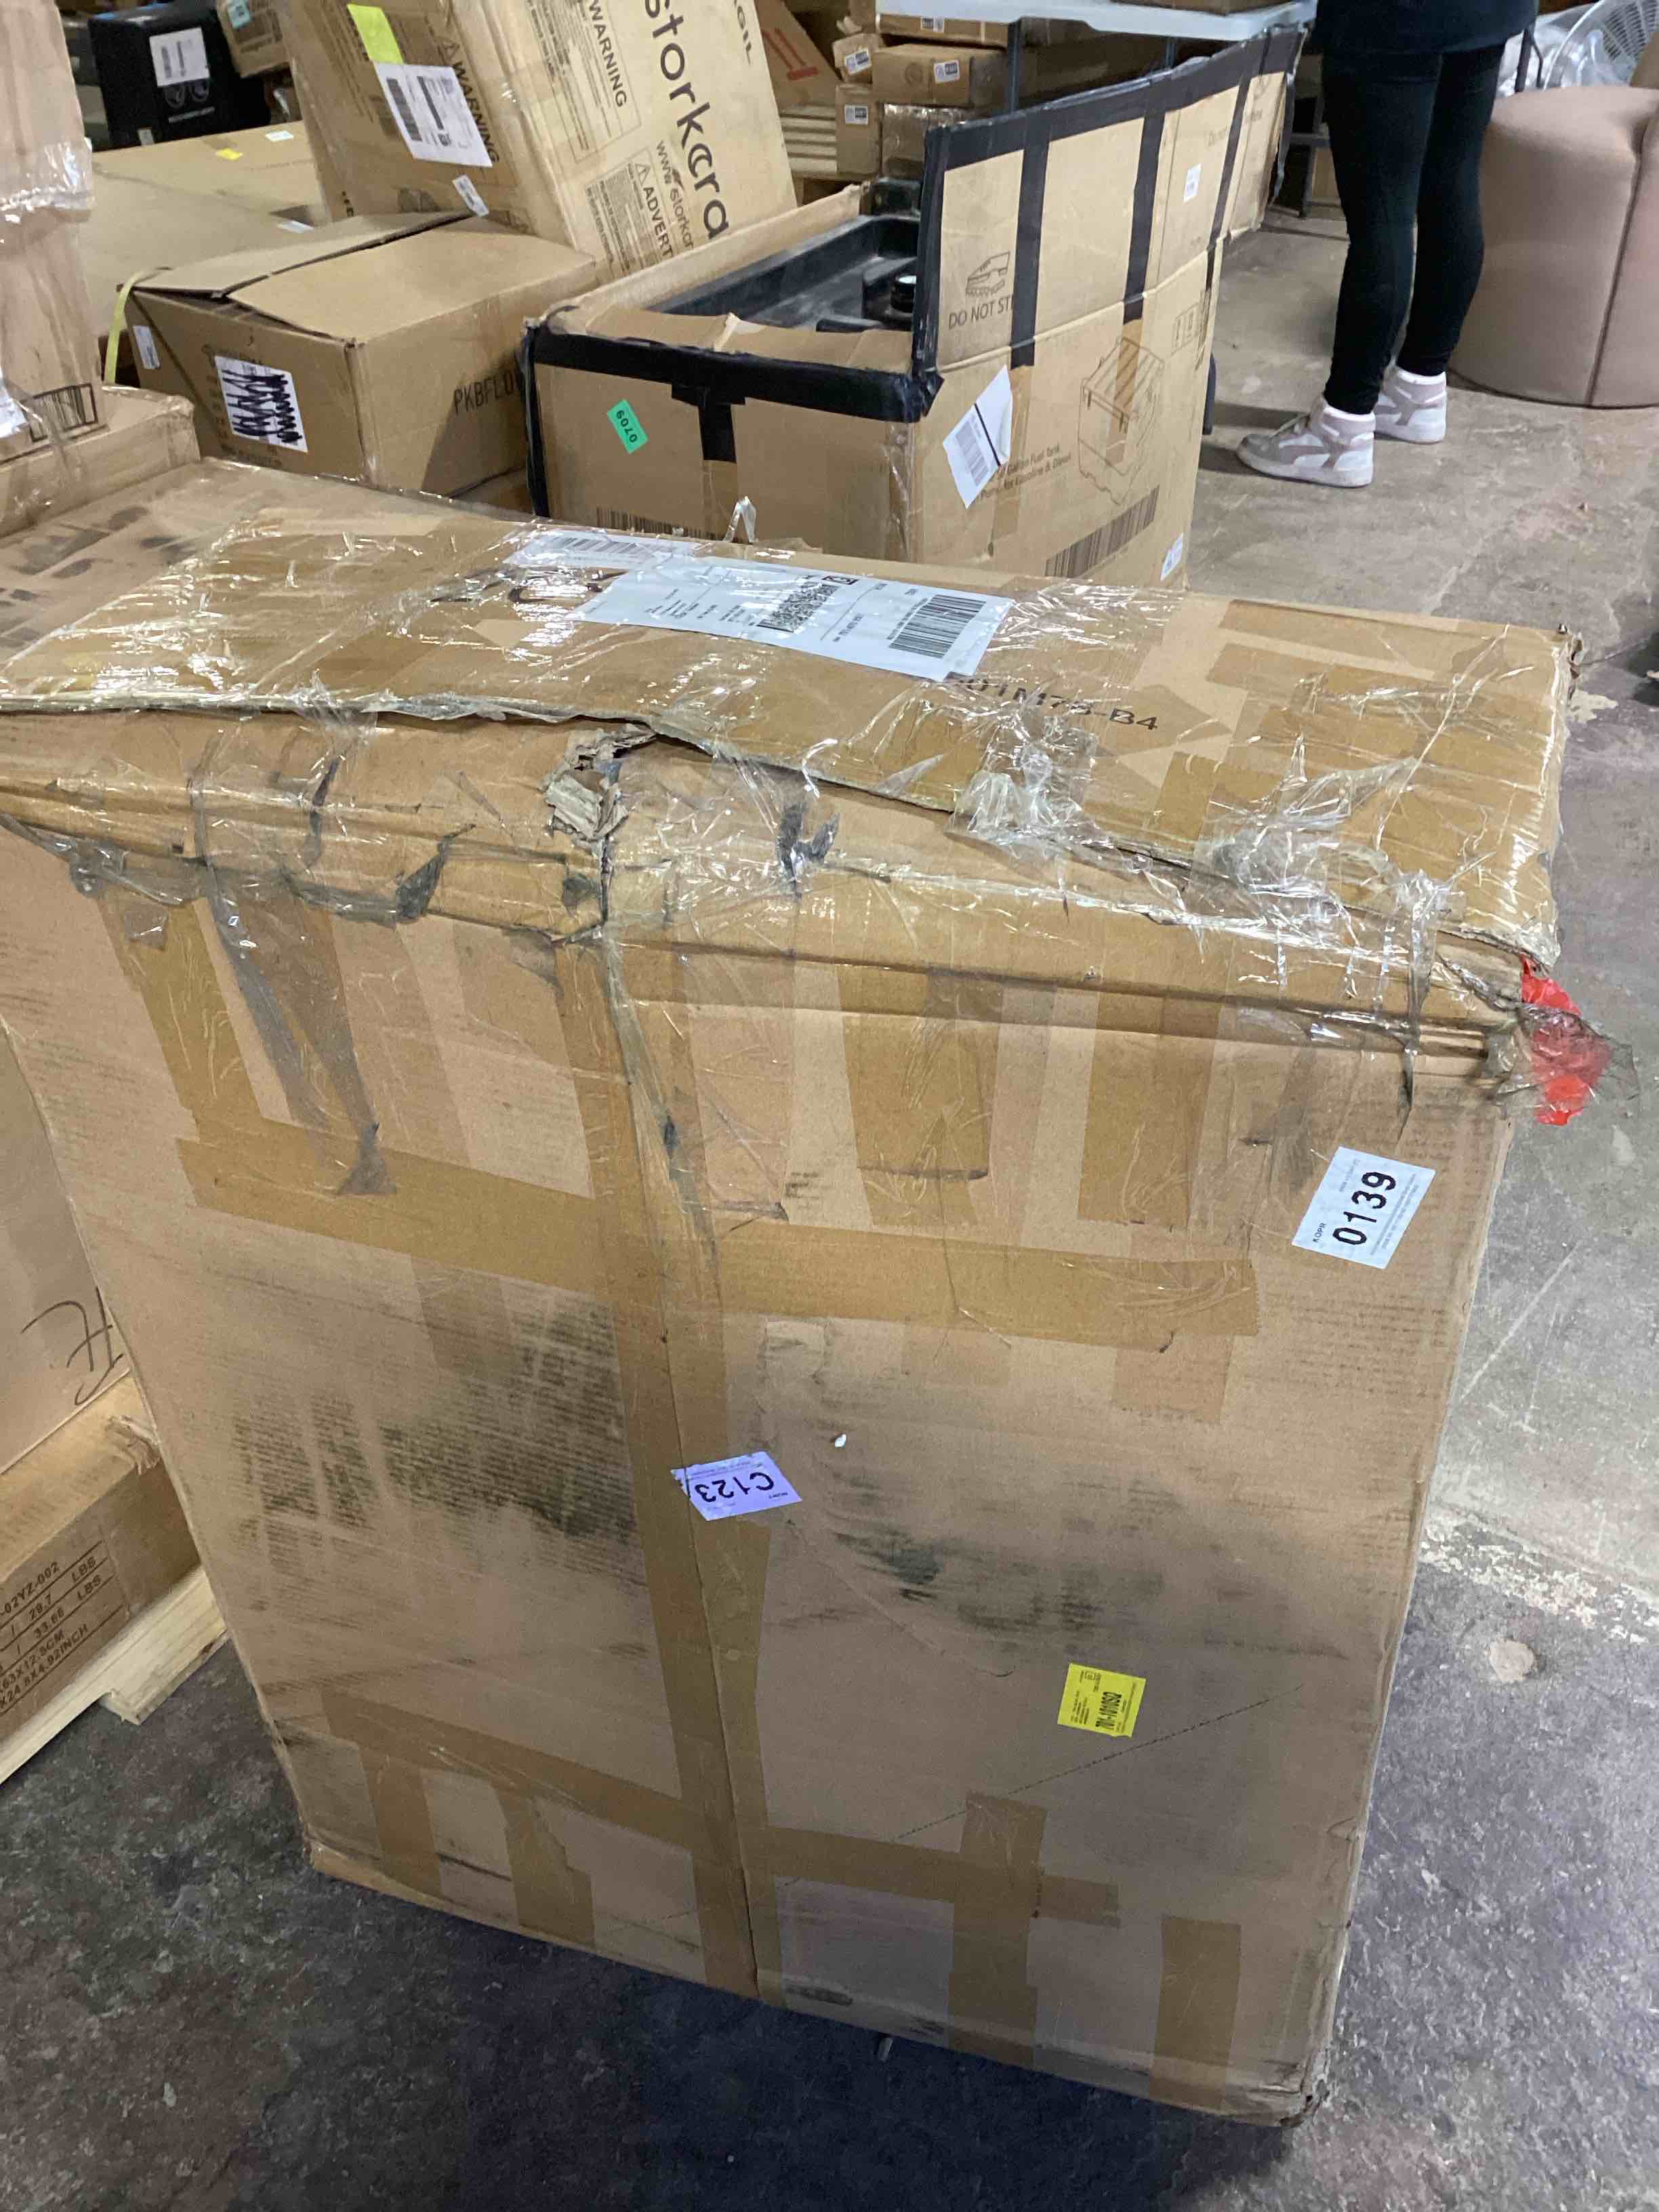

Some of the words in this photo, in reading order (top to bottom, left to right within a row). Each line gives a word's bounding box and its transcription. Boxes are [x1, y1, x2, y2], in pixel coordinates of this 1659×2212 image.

[589, 0, 628, 108] WARNING
[949, 309, 967, 330] DO
[971, 299, 996, 323] NOT
[616, 409, 638, 443] 0709
[1332, 1171, 1396, 1246] 0139
[694, 1472, 774, 1502] C123
[71, 1555, 96, 1582] LBS
[77, 1574, 102, 1601] LBS
